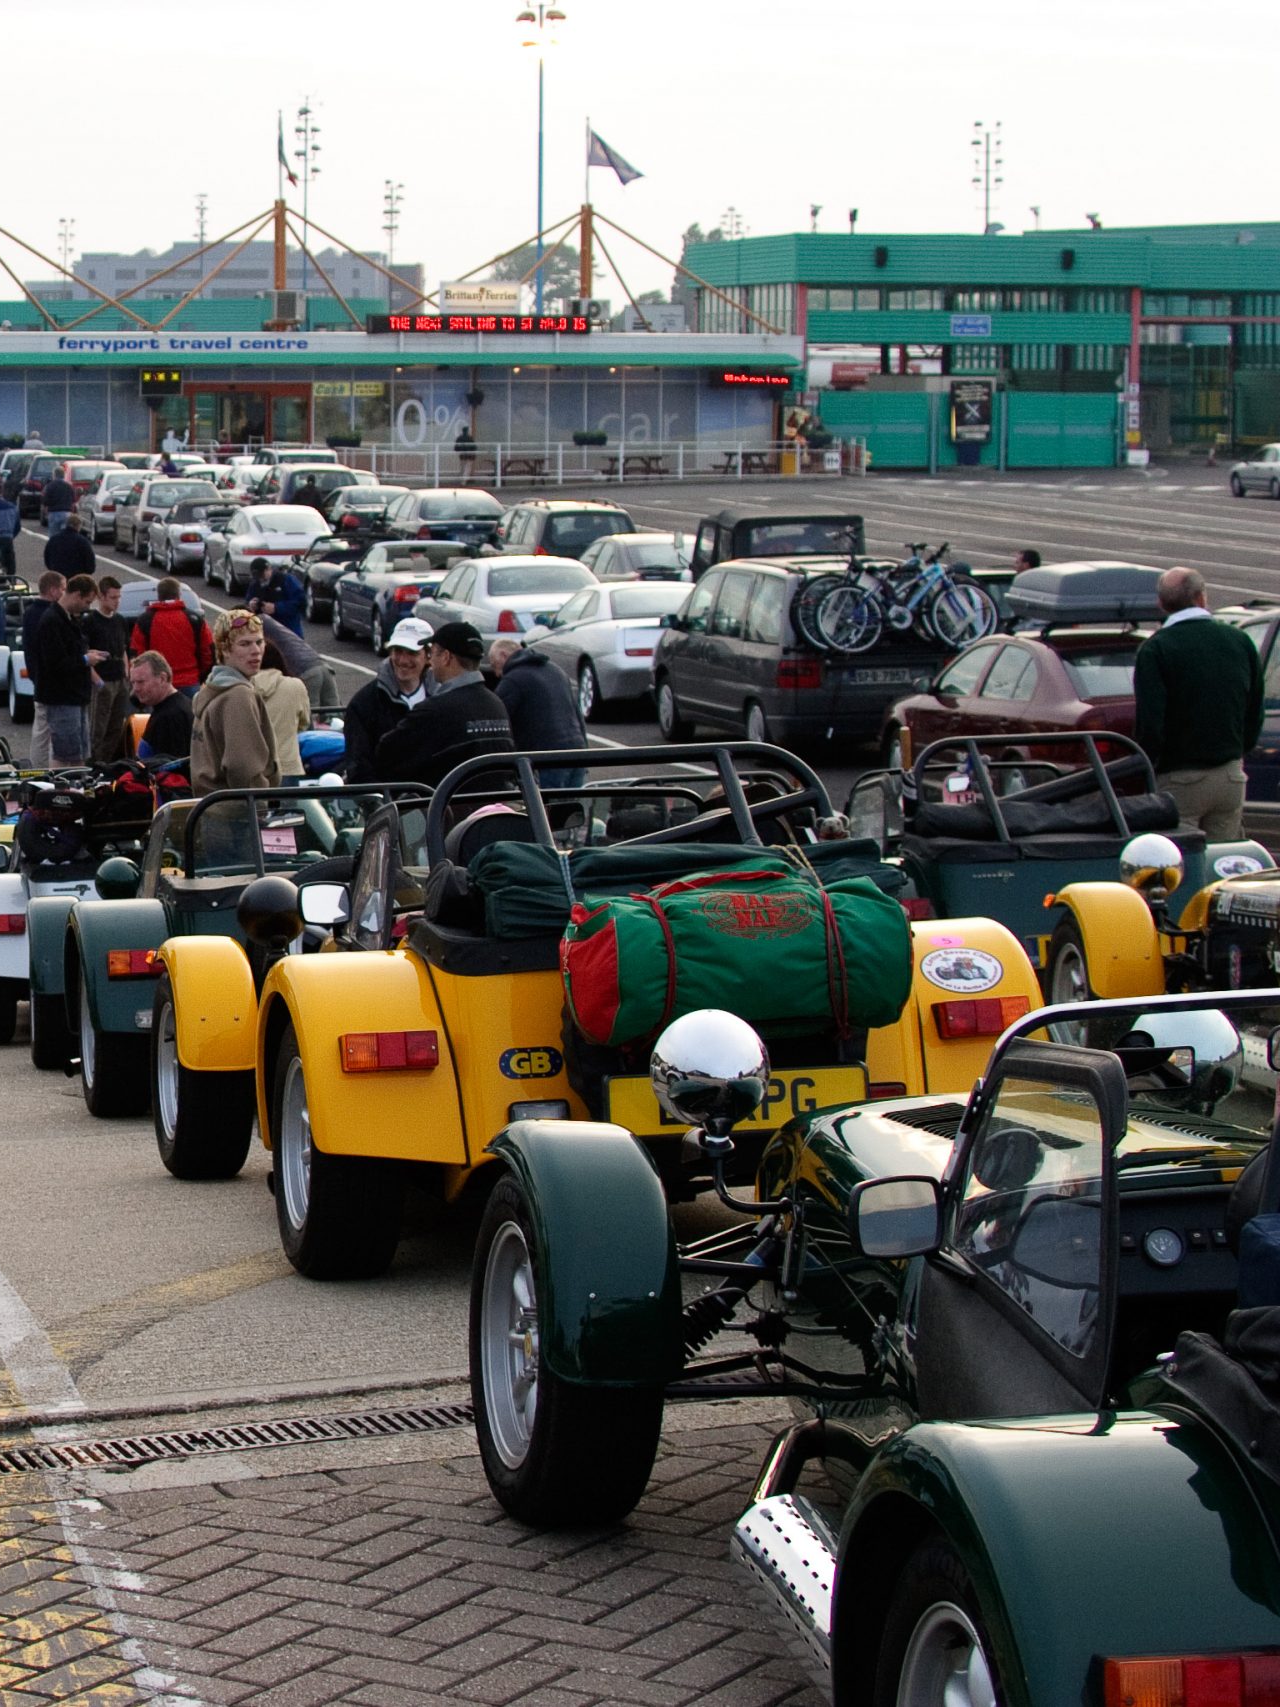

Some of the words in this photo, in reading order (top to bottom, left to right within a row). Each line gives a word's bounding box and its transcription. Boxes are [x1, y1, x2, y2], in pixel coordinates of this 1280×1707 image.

[444, 289, 483, 301] Brittany
[485, 290, 518, 300] Ferries
[389, 316, 410, 330] THE
[449, 316, 496, 330] SAILING
[502, 316, 516, 330] TO
[573, 316, 587, 330] IS
[58, 336, 160, 351] ferryport
[170, 337, 232, 350] travel
[239, 338, 308, 350] centre
[397, 399, 471, 447] 0%
[598, 412, 679, 445] car
[509, 1052, 552, 1075] GB
